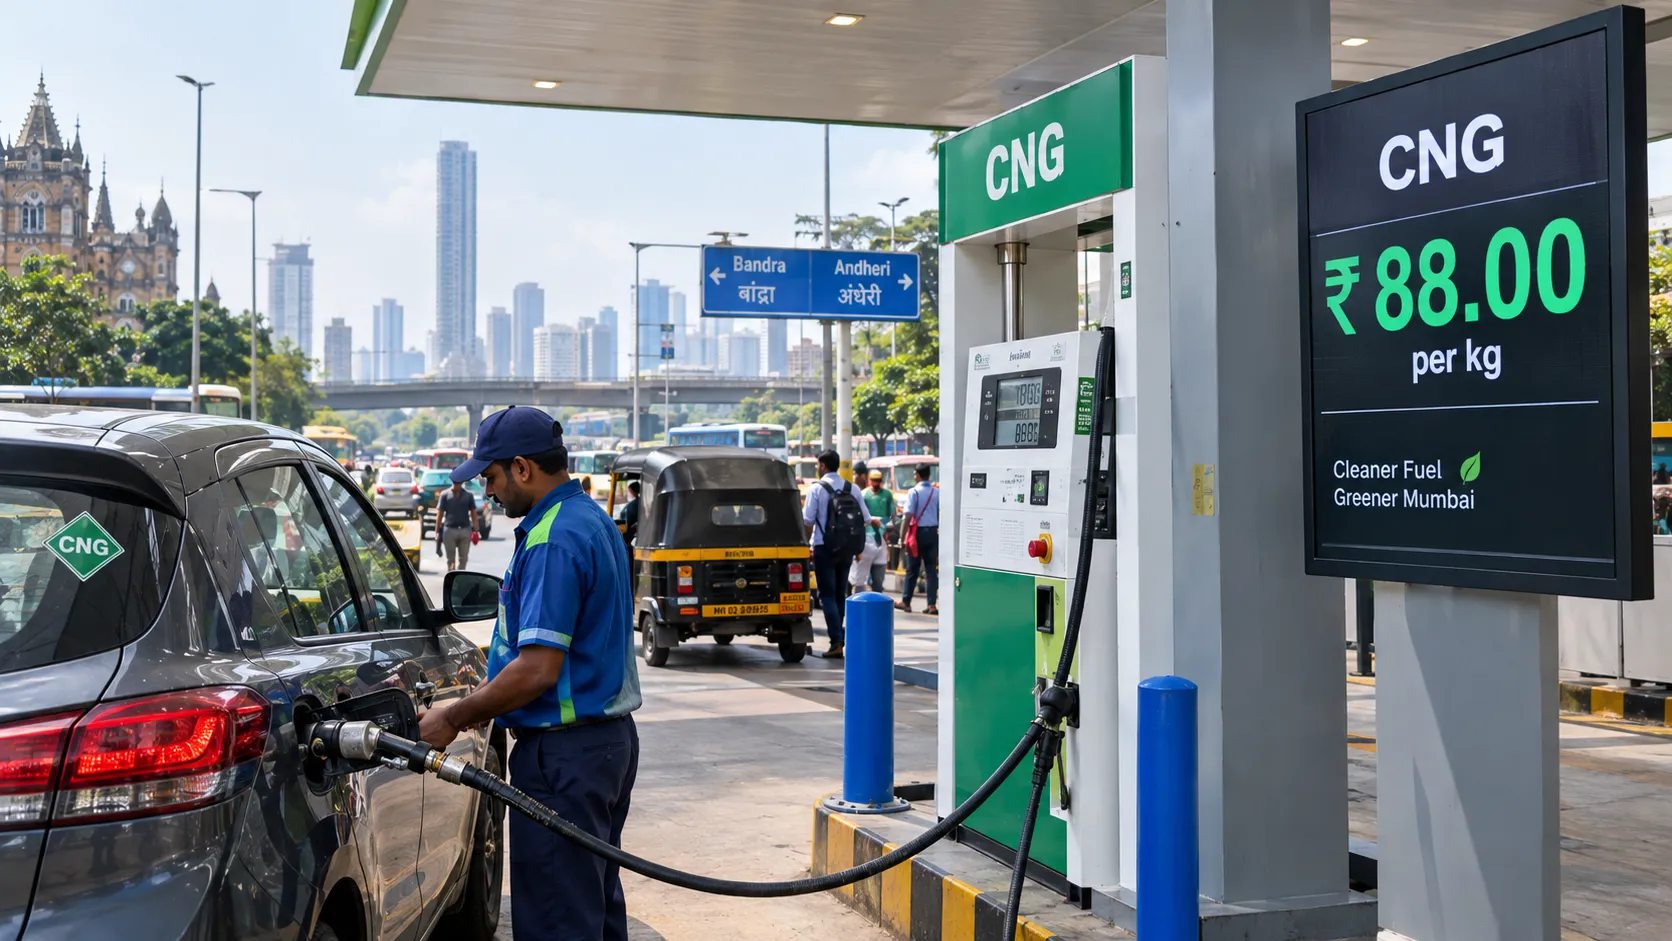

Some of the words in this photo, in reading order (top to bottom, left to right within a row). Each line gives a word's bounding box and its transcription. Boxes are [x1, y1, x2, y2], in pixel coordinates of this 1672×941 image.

[985, 121, 1065, 201] CNG
[1379, 113, 1505, 191] CNG
[733, 255, 786, 273] Bandra
[834, 259, 891, 277] Andheri
[1325, 255, 1360, 335] ₹
[1375, 217, 1586, 331] 88.00
[738, 281, 776, 305] बांद्रा
[837, 283, 882, 306] अंधेरी
[1412, 348, 1457, 384] per
[1466, 338, 1502, 380] kg
[1333, 459, 1398, 479] Cleaner
[1403, 459, 1443, 479] Fuel
[1334, 487, 1398, 507] Greener
[1403, 488, 1475, 510] Mumbai
[58, 535, 109, 556] CNG
